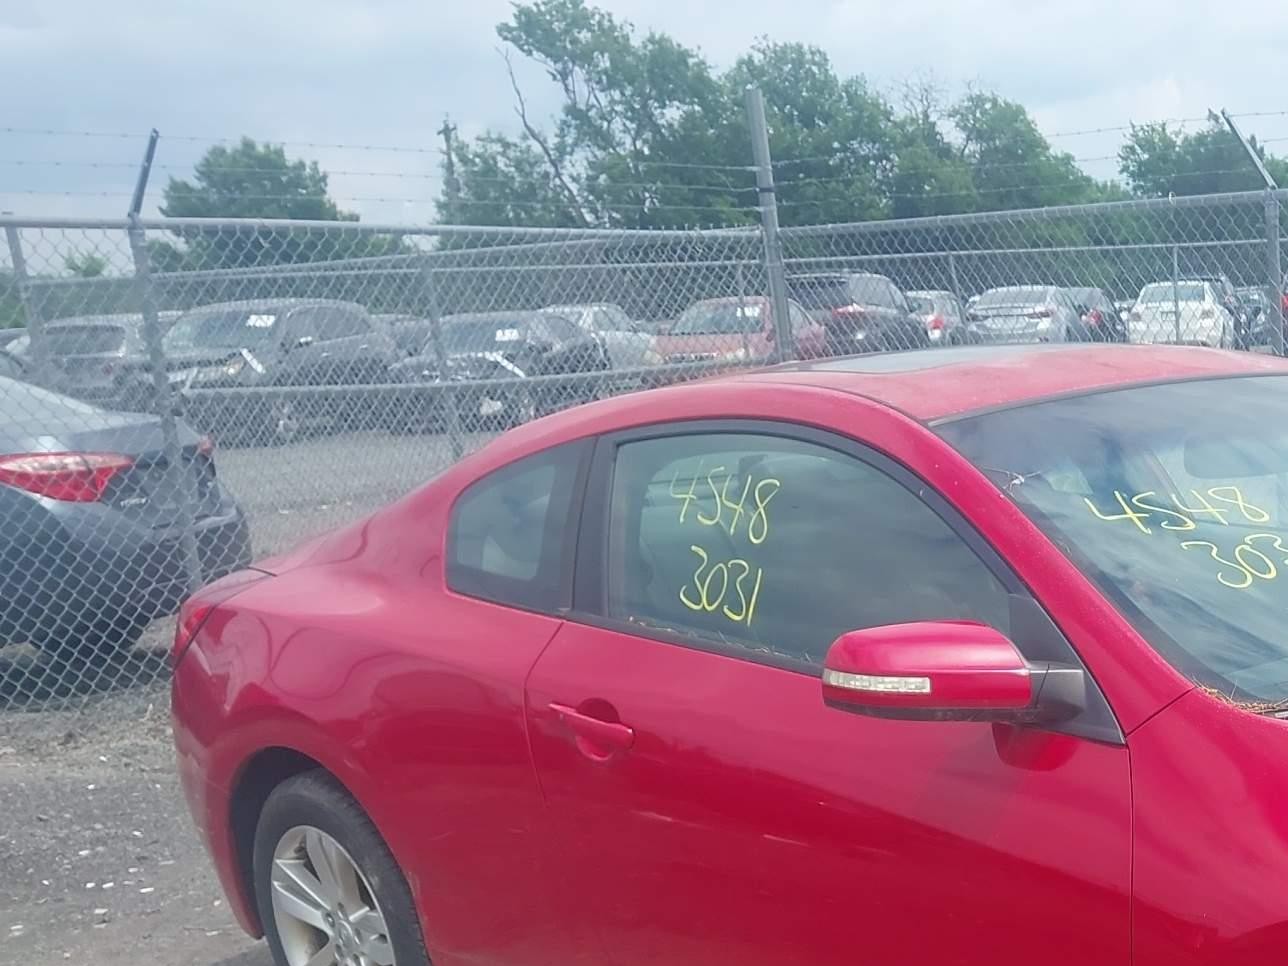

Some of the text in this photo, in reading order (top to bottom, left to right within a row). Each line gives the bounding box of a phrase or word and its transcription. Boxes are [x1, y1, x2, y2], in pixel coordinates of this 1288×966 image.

[669, 459, 781, 544] 4548
[1083, 485, 1270, 535] 4548
[679, 544, 763, 627] 3031
